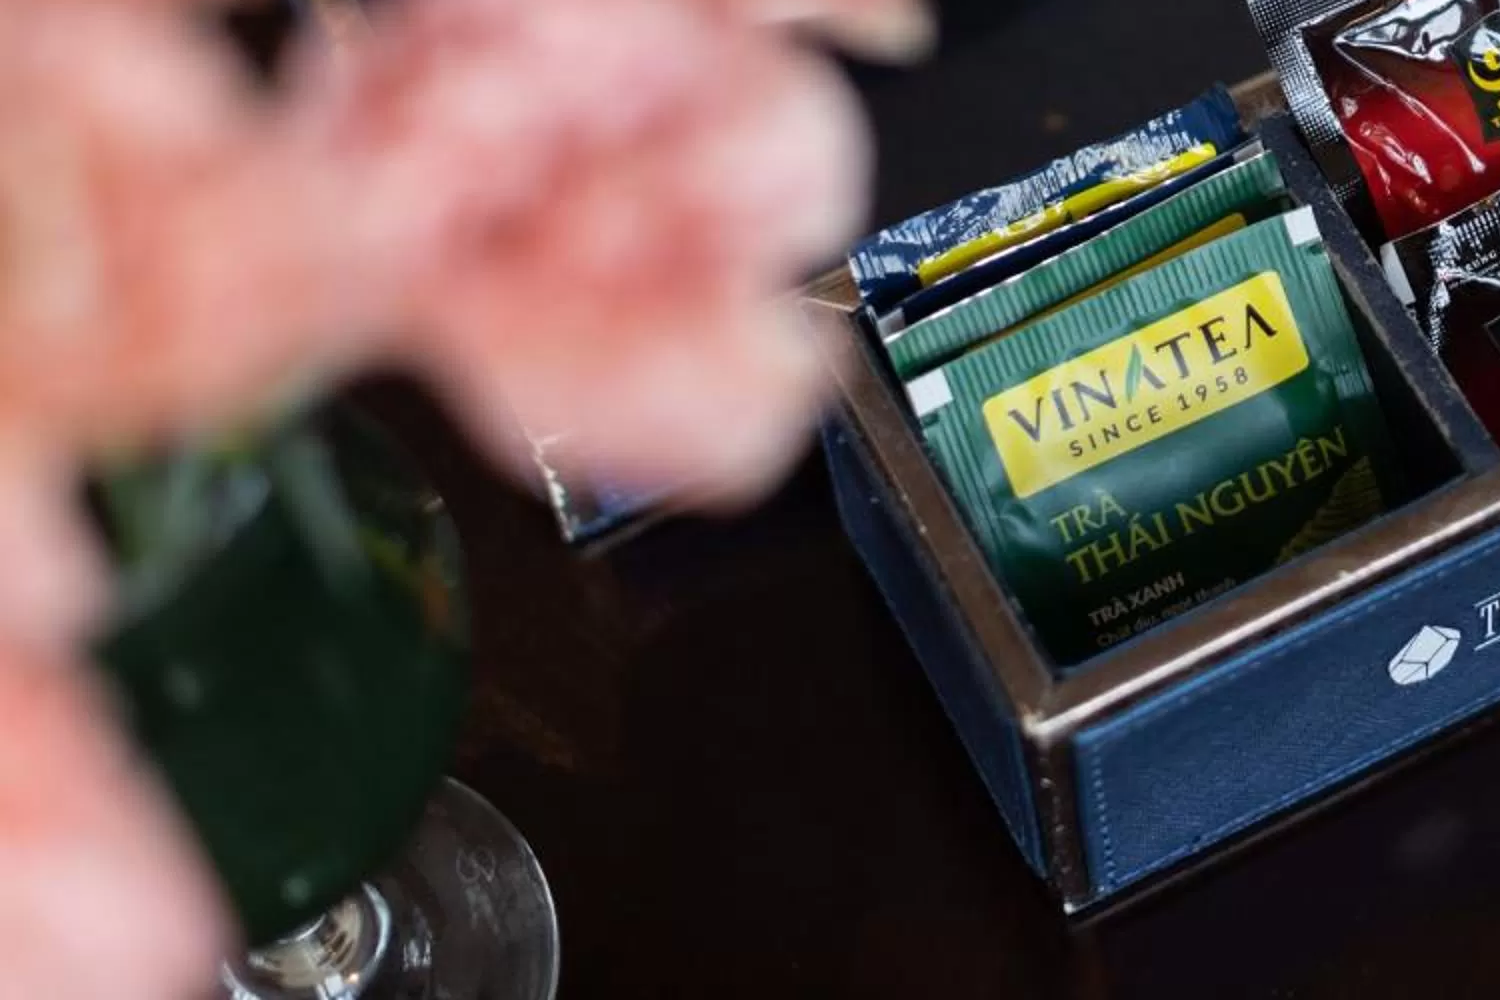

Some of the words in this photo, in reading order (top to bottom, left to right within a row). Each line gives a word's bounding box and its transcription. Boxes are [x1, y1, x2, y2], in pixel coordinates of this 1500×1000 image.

[1008, 302, 1278, 443] VINATEA
[1069, 405, 1163, 457] SINCE
[1178, 366, 1249, 412] 1958
[1065, 512, 1174, 584] THÁI
[1174, 423, 1347, 536] NGUYÊN
[1088, 595, 1128, 627] TRÀ
[1127, 571, 1185, 609] XANH
